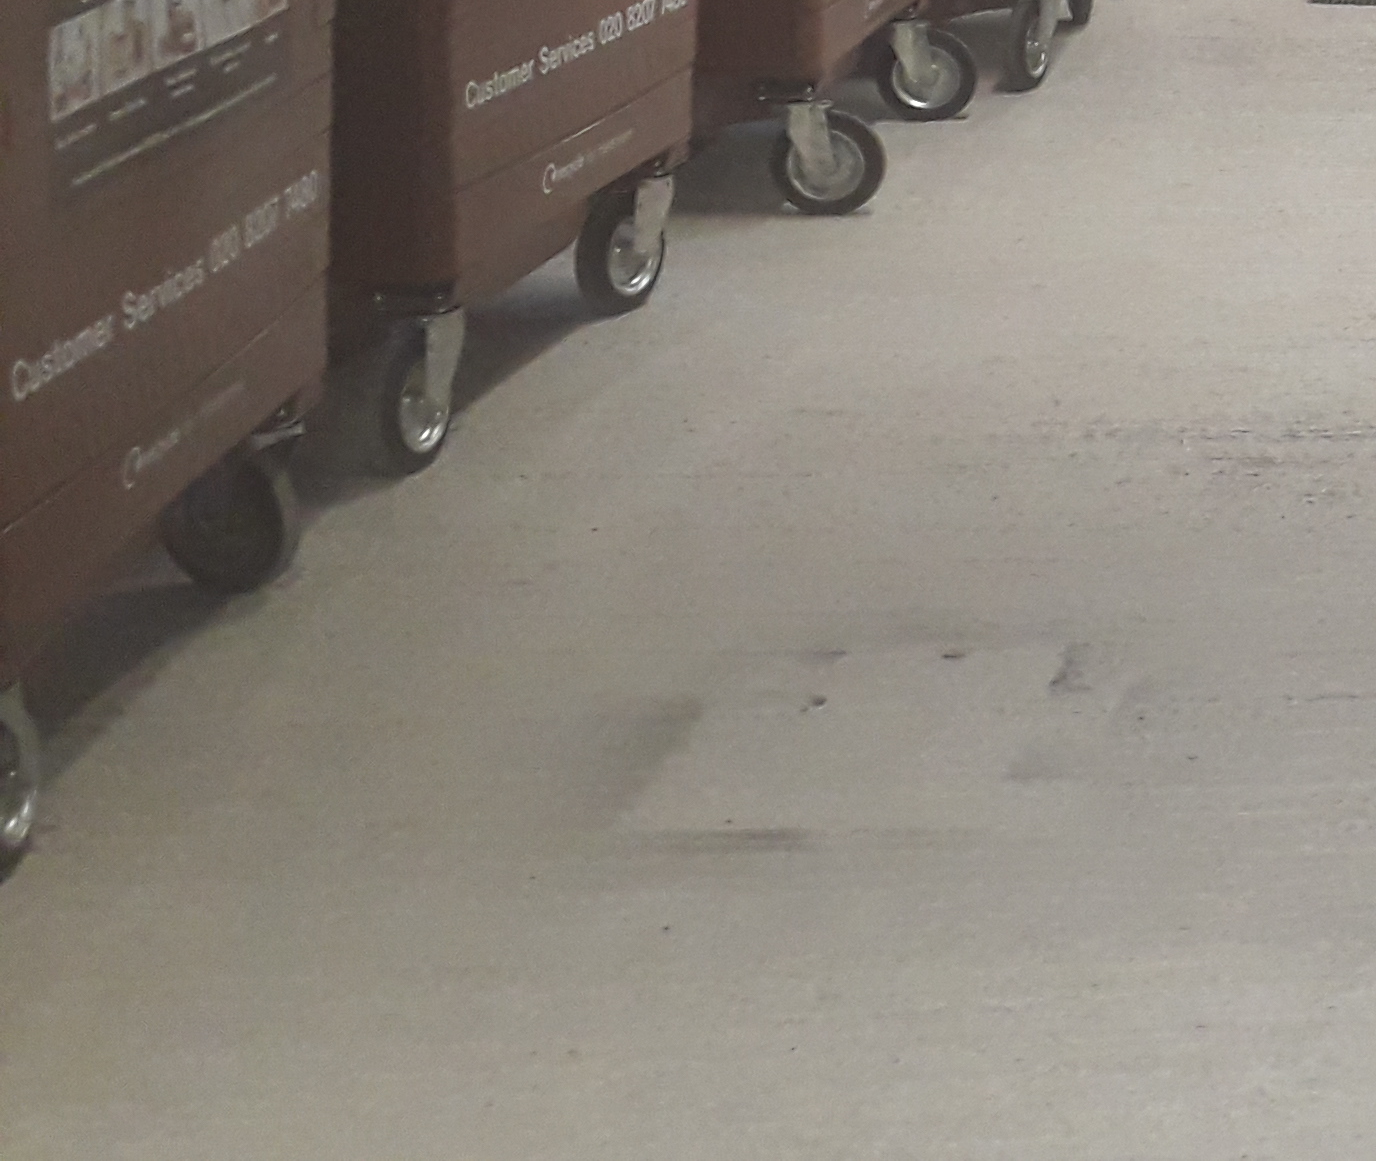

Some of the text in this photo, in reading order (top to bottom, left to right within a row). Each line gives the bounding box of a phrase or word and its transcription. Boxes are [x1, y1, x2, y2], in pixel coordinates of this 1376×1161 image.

[465, 59, 535, 110] Customer
[539, 31, 595, 75] Services
[600, 11, 623, 45] 020
